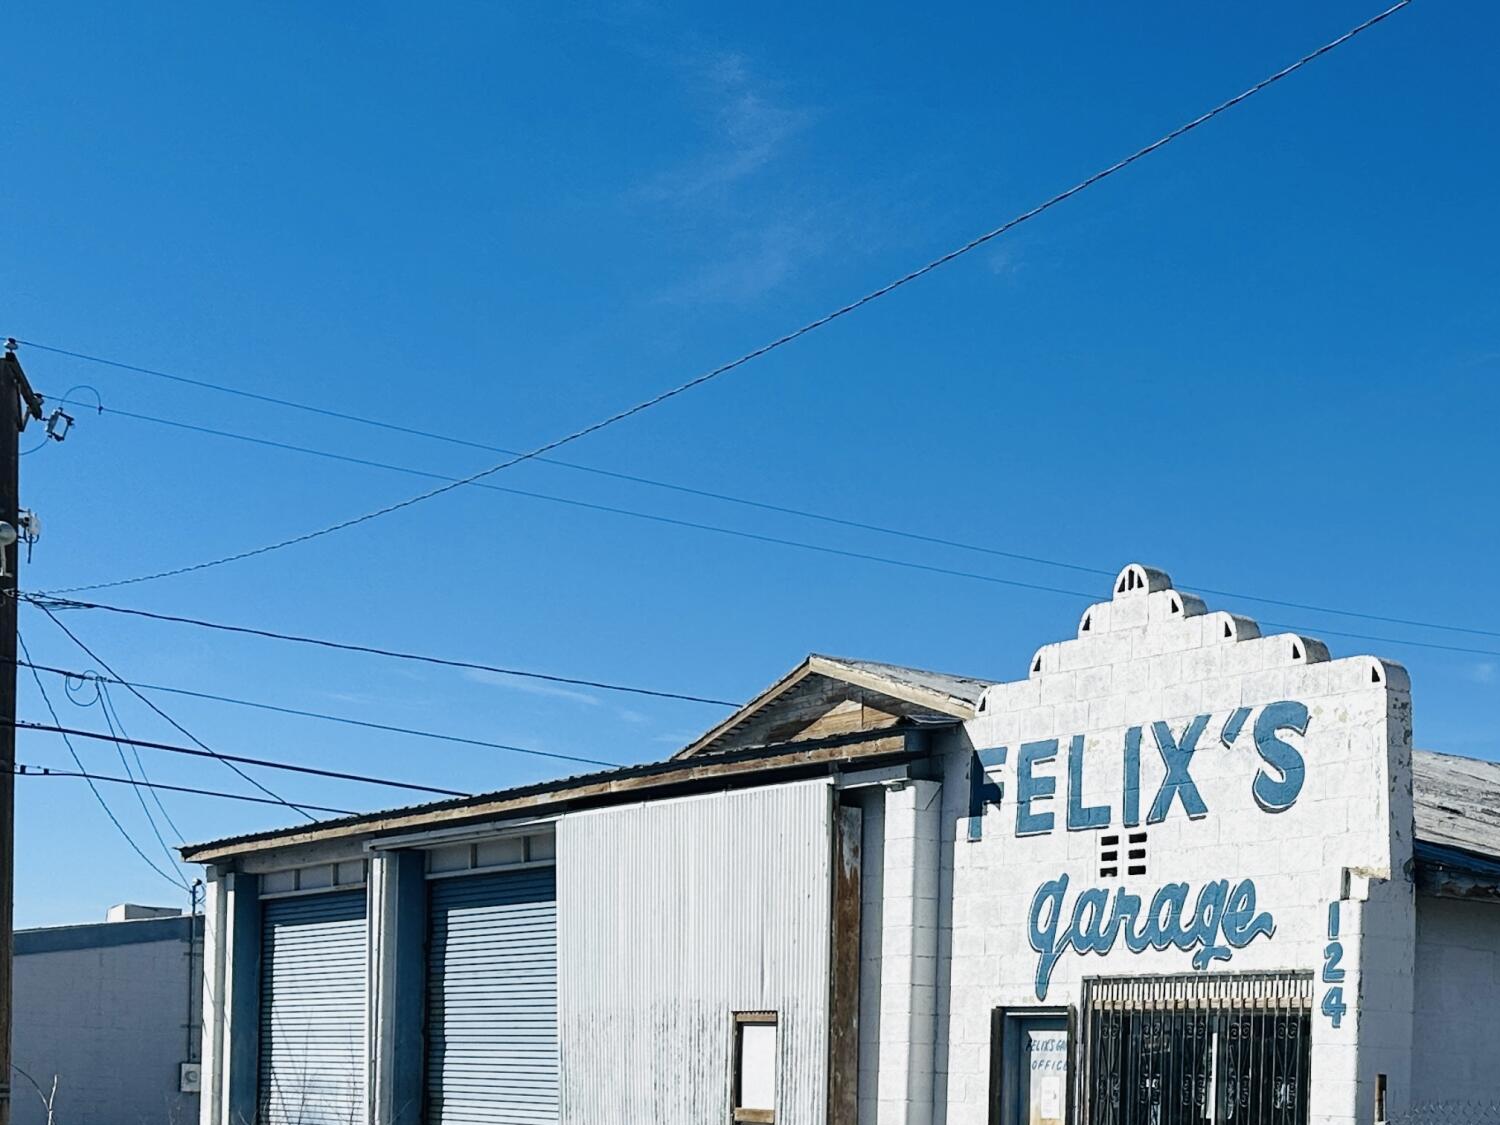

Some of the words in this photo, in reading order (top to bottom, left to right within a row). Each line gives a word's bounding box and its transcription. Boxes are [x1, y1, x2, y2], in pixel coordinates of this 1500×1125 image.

[967, 701, 1312, 842] FELIX'S
[1028, 872, 1276, 1001] garage
[1321, 901, 1347, 1029] 124
